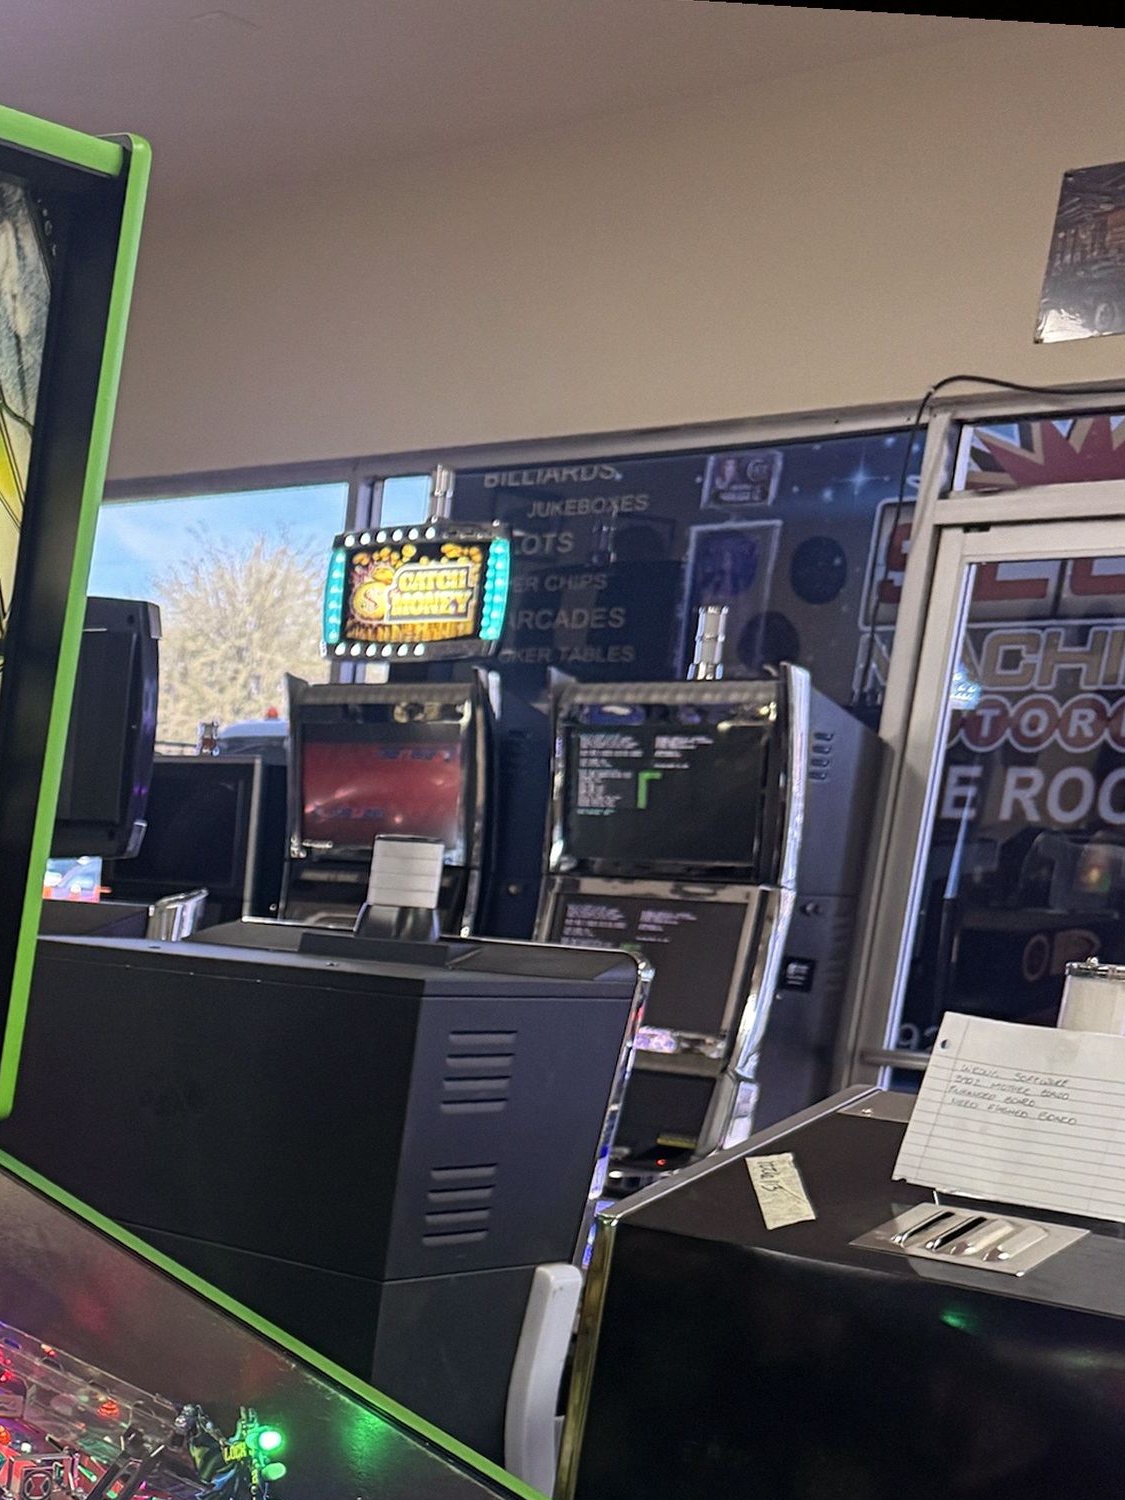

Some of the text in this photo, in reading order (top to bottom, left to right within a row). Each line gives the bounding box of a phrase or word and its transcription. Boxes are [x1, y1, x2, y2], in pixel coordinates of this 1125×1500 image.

[527, 495, 649, 519] JUKEBOXES
[398, 570, 468, 592] CATCH
[544, 573, 609, 592] CHIPS
[559, 645, 636, 663] TABLES
